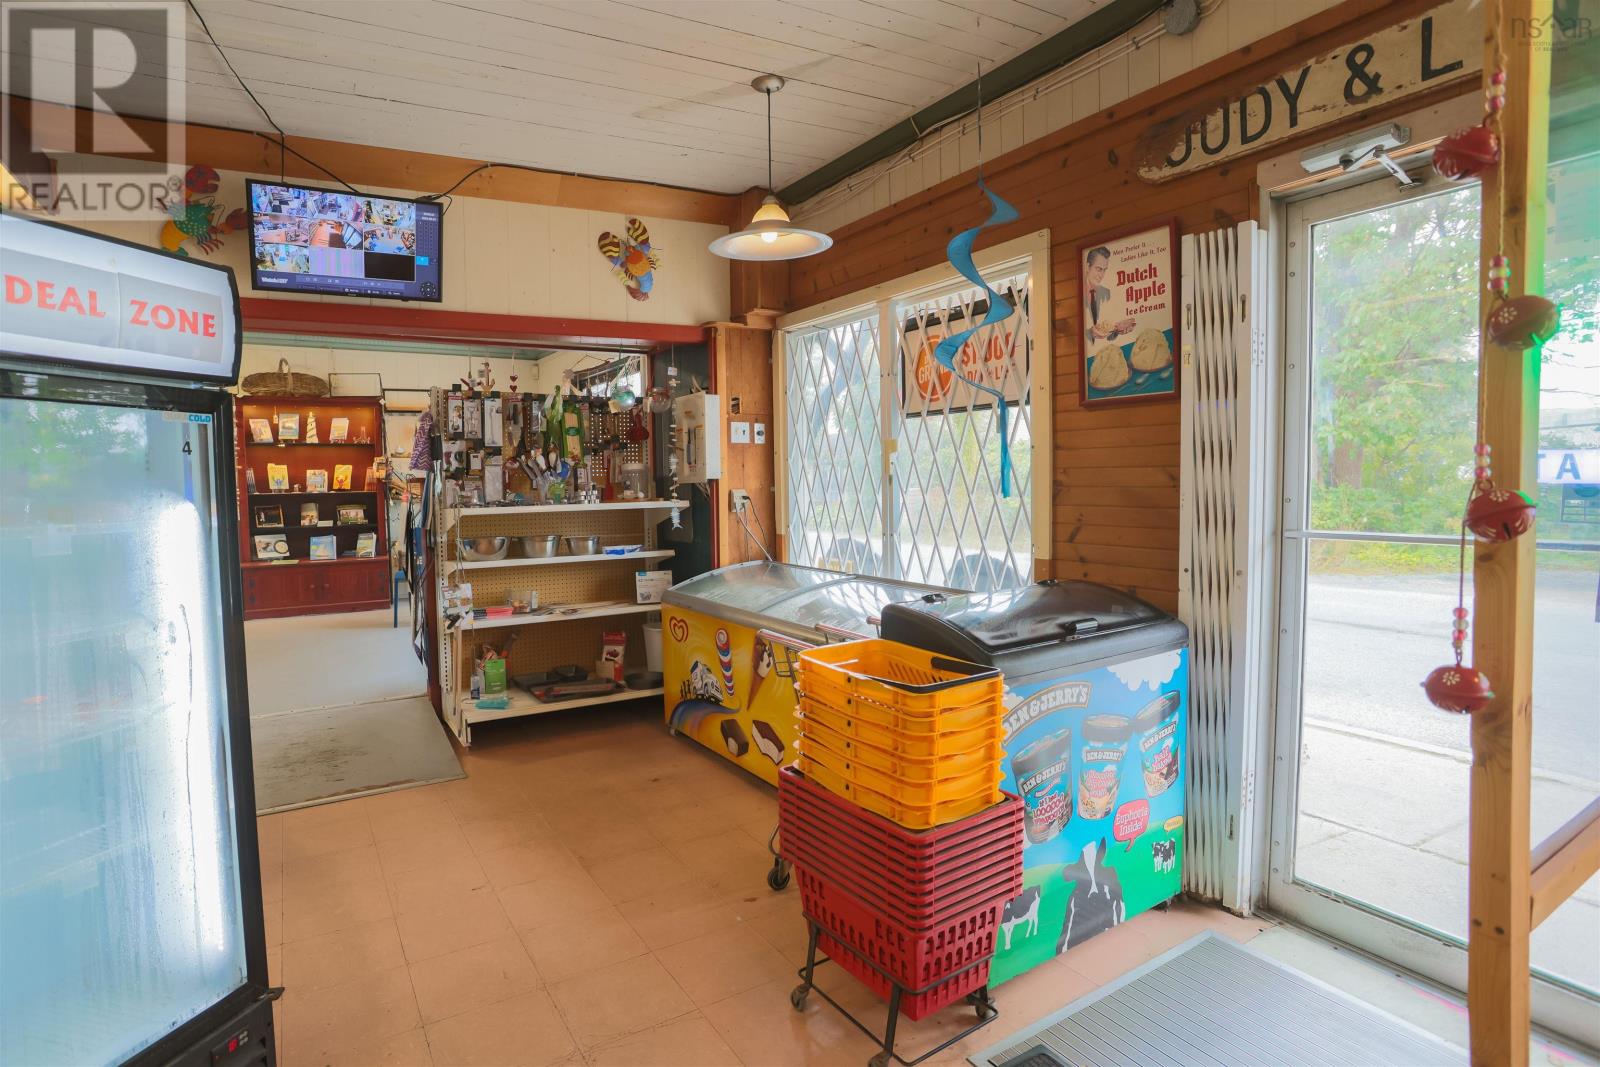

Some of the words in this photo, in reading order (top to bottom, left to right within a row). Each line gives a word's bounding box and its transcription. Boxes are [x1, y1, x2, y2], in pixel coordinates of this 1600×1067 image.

[1166, 66, 1311, 168] JUDY
[1343, 43, 1384, 102] &
[1117, 263, 1158, 286] Dutch
[1126, 281, 1166, 303] Apple
[5, 275, 106, 318] DEAL
[129, 300, 216, 338] ZONE
[1126, 307, 1138, 316] Ice
[1139, 303, 1166, 314] Cream
[189, 414, 212, 422] COLD
[182, 441, 192, 455] 4
[1041, 685, 1088, 712] JERRY'S
